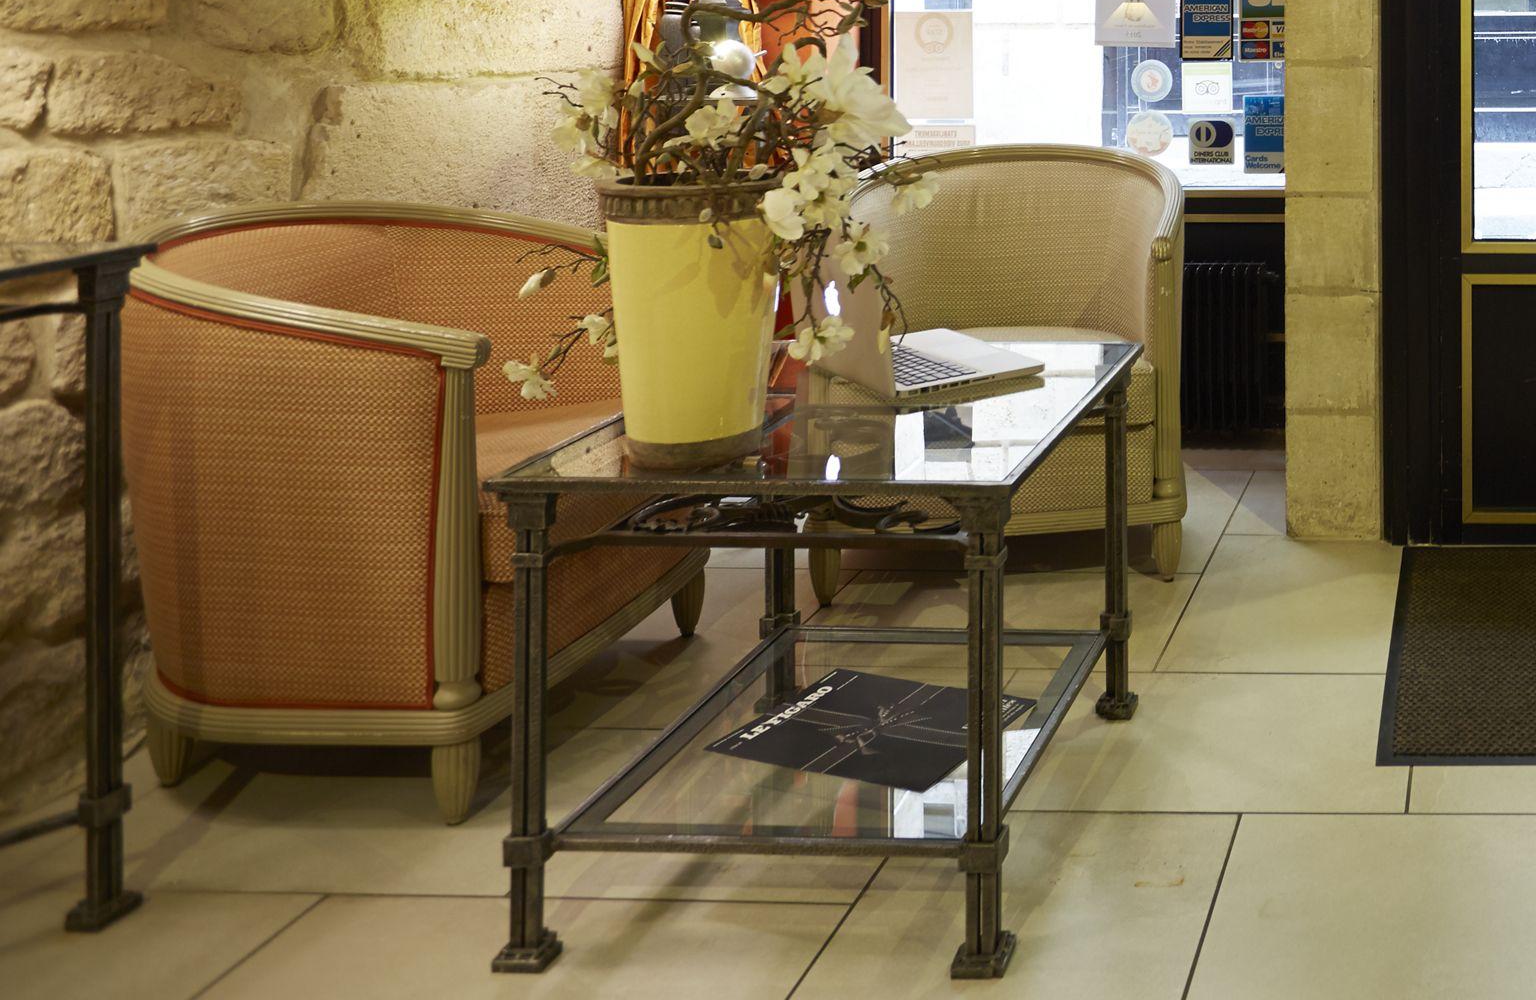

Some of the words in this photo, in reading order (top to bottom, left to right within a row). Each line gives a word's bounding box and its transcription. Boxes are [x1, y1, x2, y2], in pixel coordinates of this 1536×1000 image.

[1183, 4, 1229, 12] AMERICAN
[1193, 13, 1231, 22] EXPRESS
[740, 725, 771, 740] LE
[762, 686, 833, 725] FIGARO
